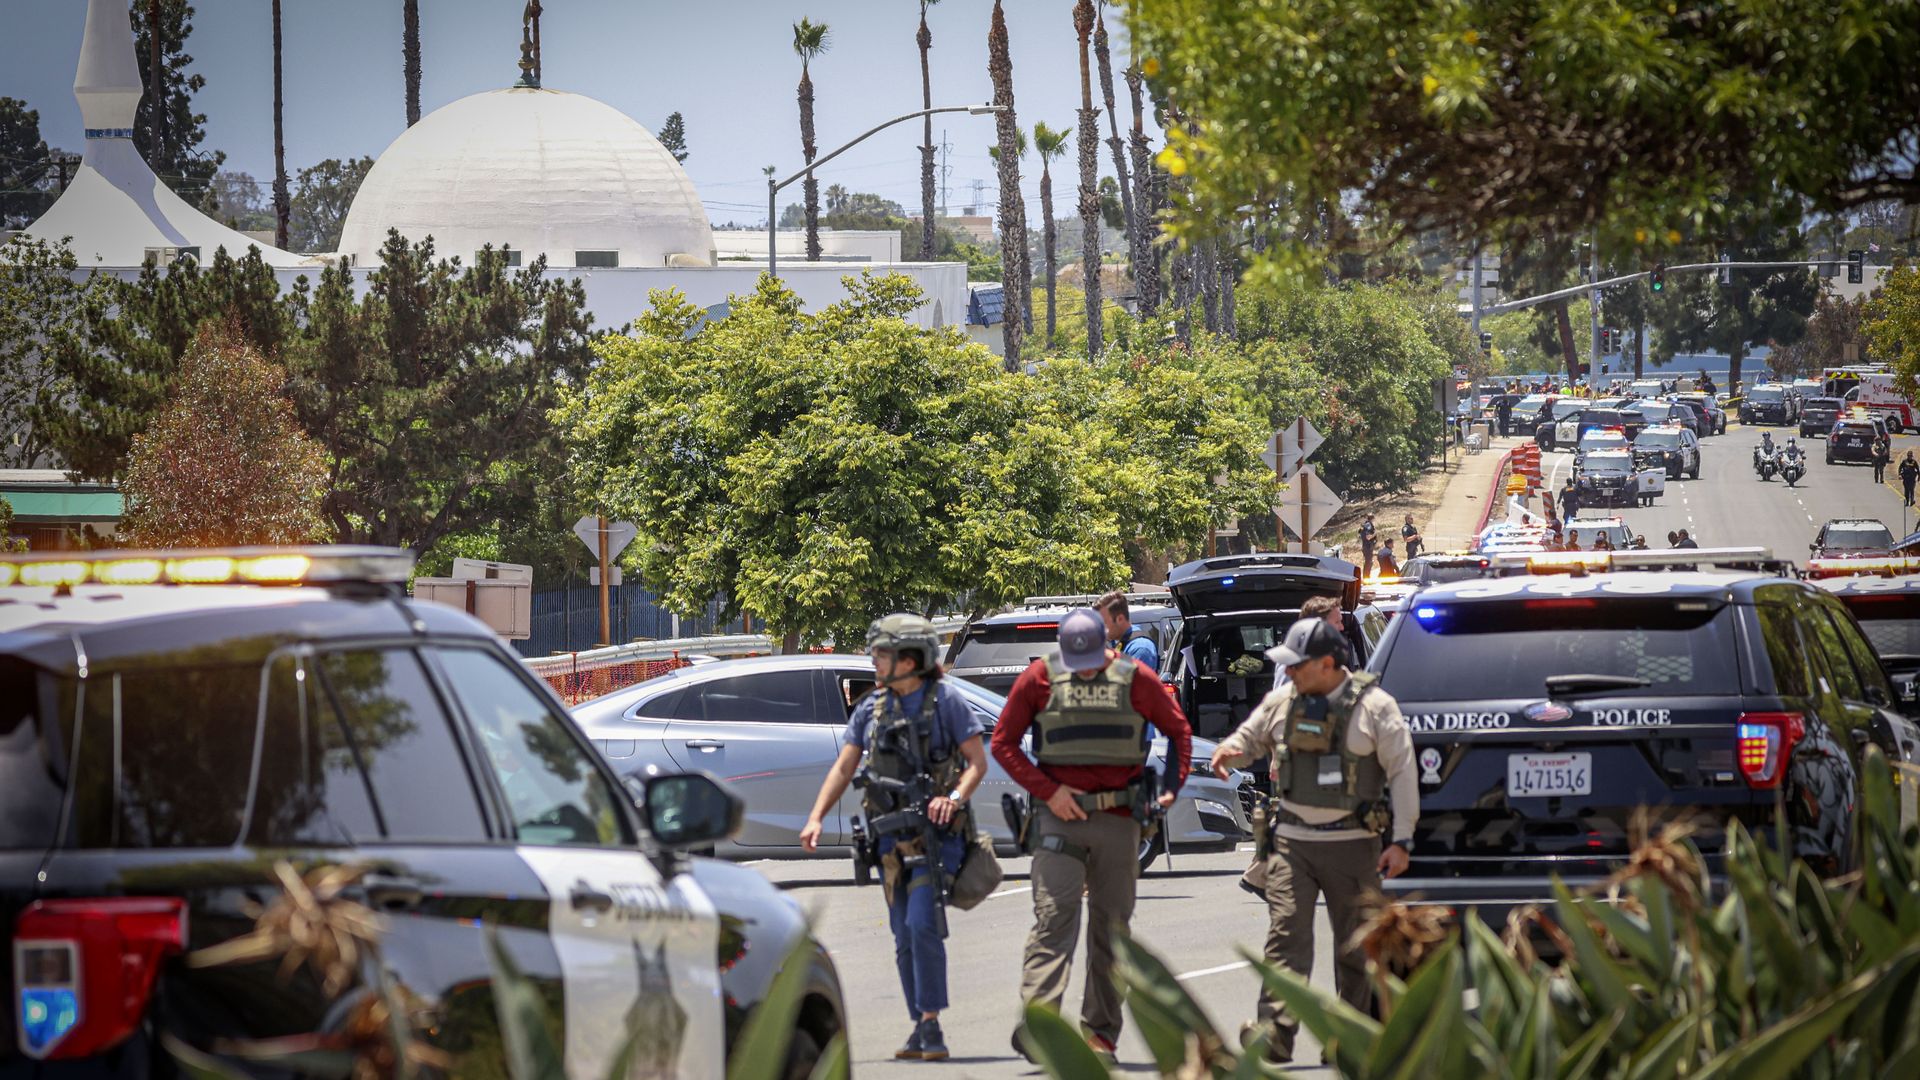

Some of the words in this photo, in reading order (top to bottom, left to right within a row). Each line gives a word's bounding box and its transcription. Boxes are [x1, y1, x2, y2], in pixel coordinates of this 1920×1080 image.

[981, 666, 1002, 675] SAN
[1004, 665, 1029, 673] DIE
[1064, 684, 1118, 700] POLICE
[1443, 711, 1510, 729] DIEGO
[1592, 708, 1672, 726] POLICE
[1514, 768, 1586, 790] 1471516
